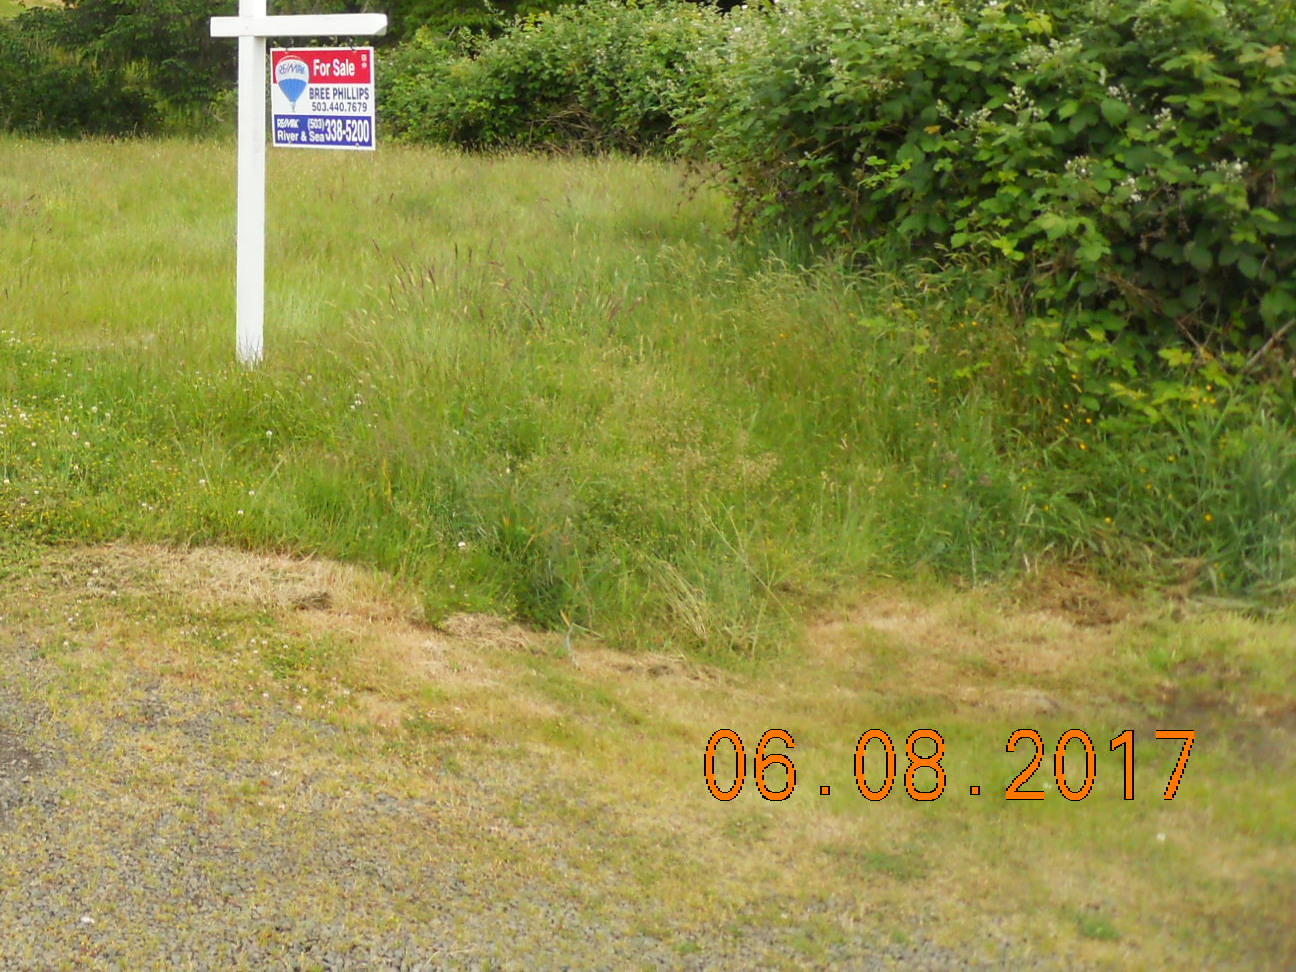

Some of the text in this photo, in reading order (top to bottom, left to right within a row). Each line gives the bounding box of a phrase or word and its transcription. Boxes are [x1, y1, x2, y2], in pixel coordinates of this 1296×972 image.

[313, 59, 355, 76] For Sale
[309, 88, 369, 100] BREE PHILLIPS
[311, 102, 368, 112] 503.440.7679
[277, 130, 325, 143] River & Sea
[325, 119, 370, 143] 338-5200
